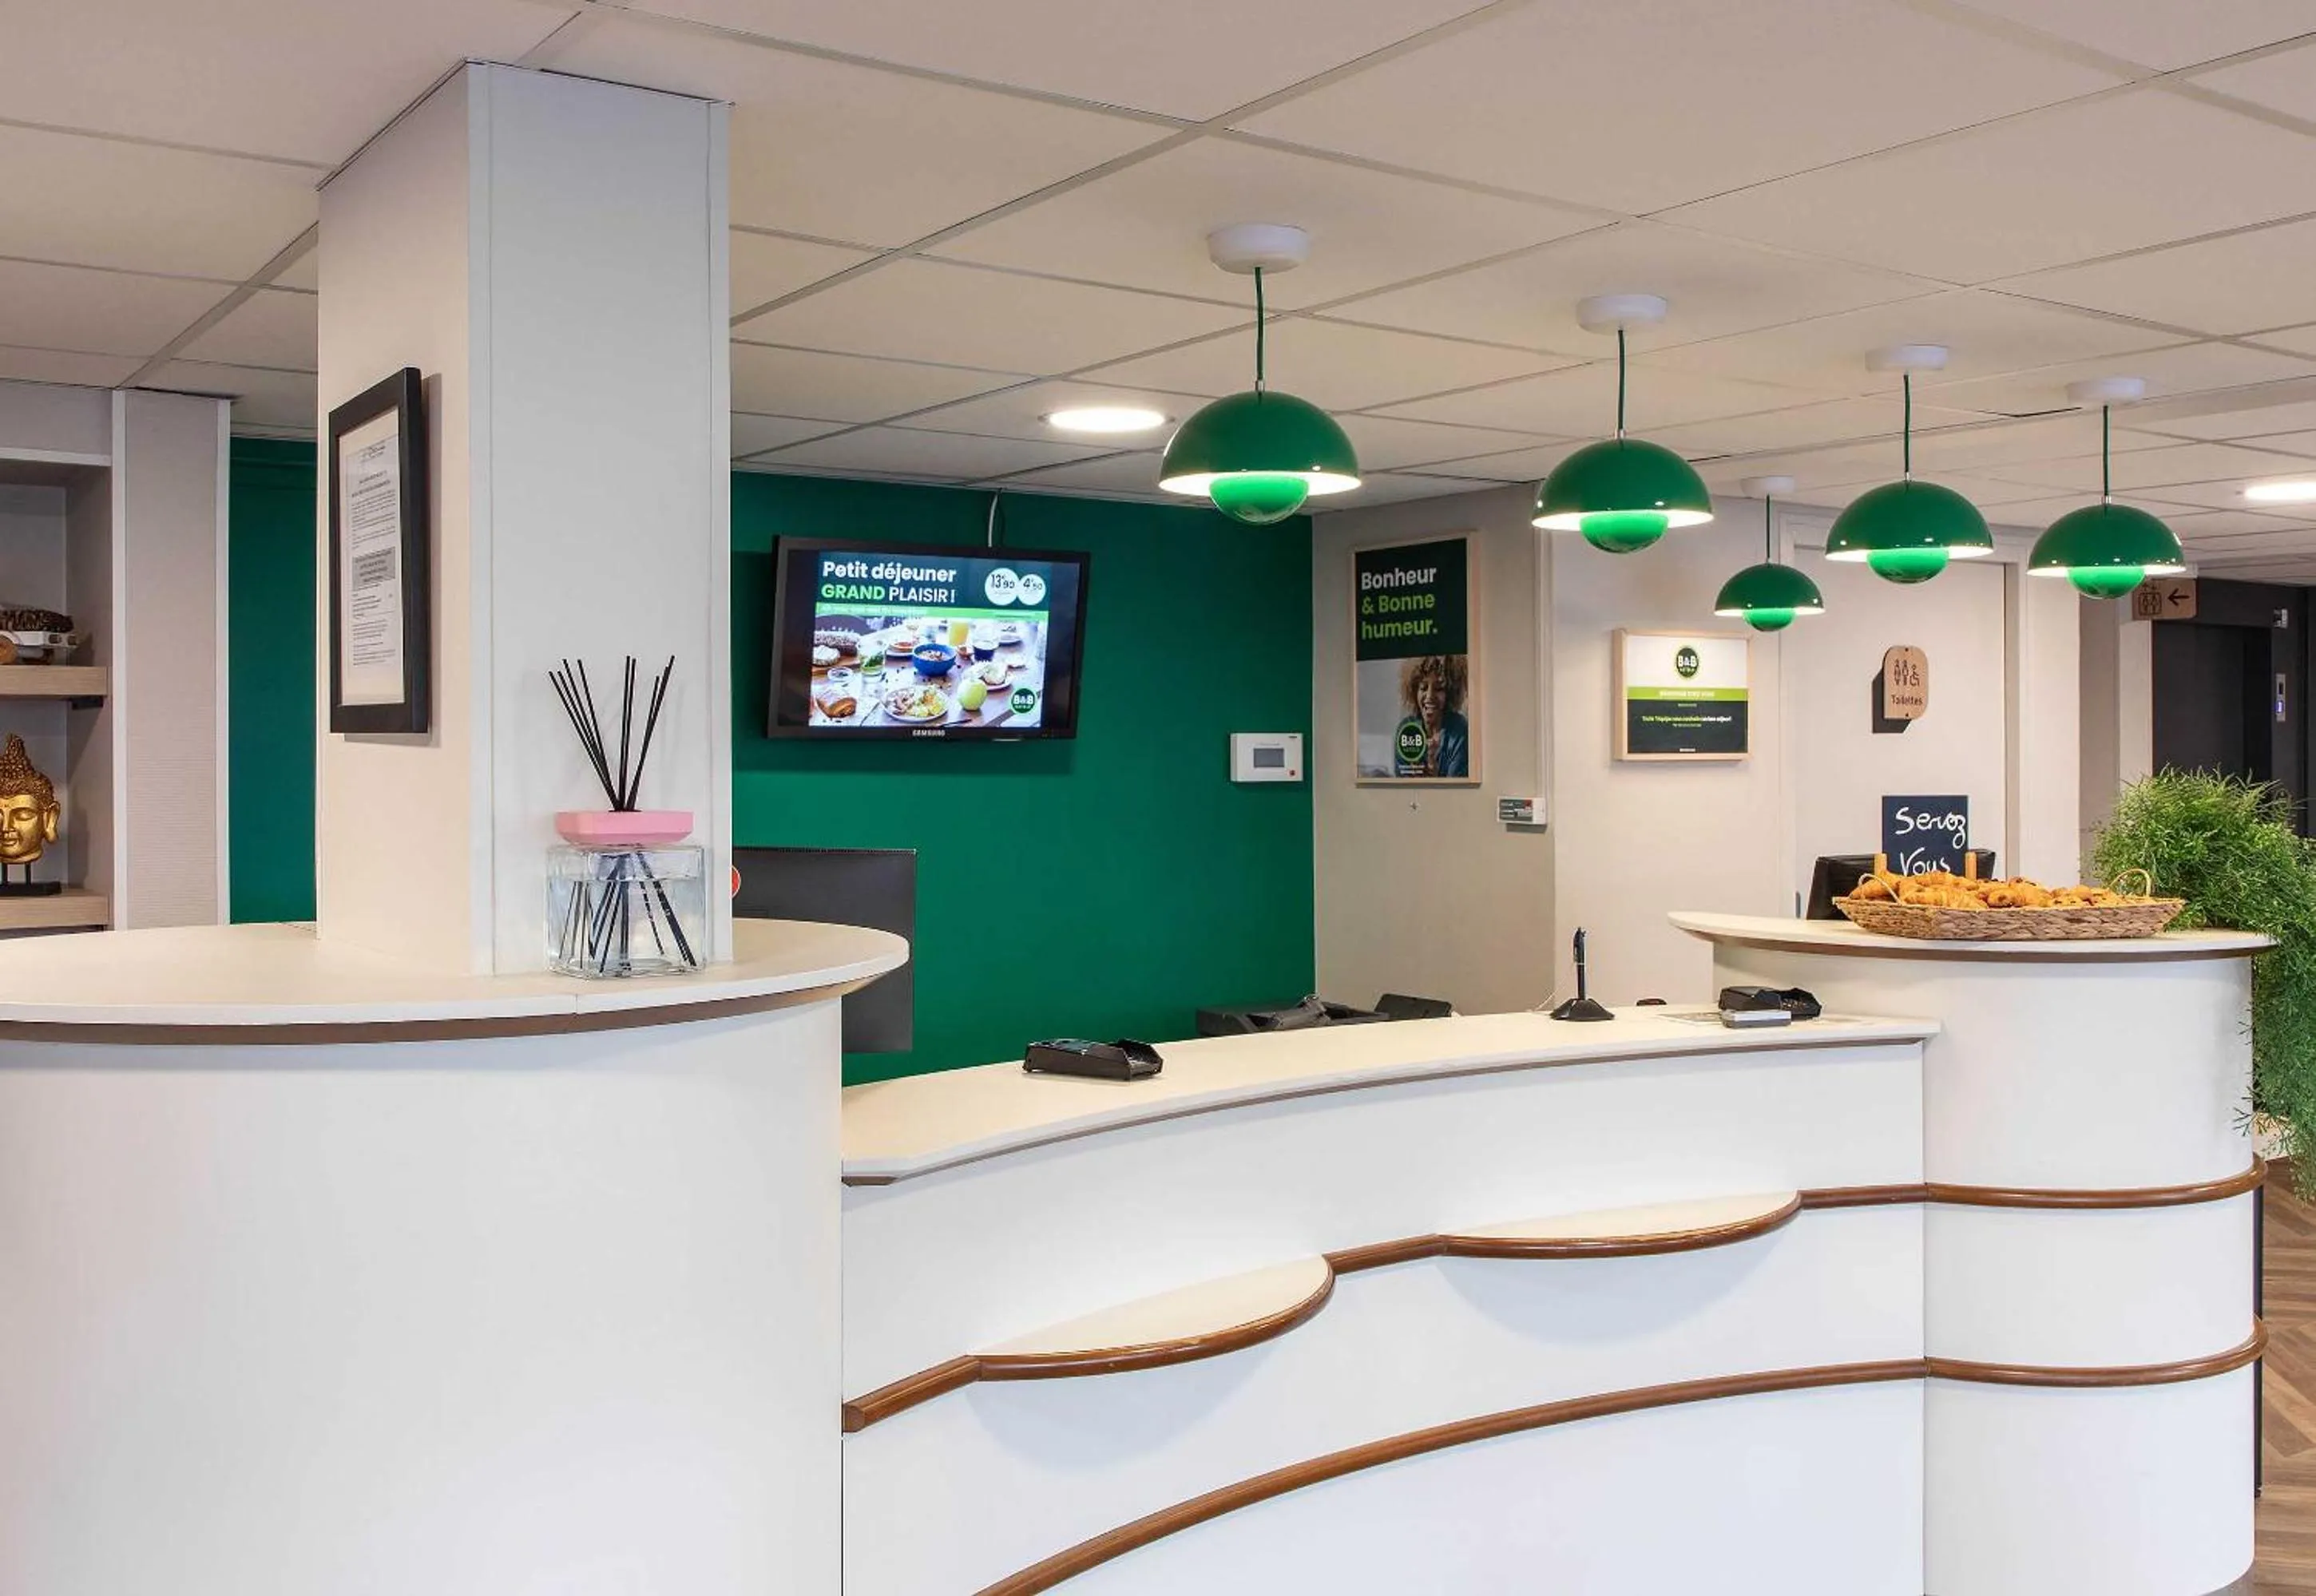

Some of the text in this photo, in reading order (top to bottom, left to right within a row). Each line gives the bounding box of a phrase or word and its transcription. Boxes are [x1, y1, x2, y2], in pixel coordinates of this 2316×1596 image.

[823, 561, 957, 585] Petit déjeuner
[1362, 568, 1437, 590] Bonheur
[821, 584, 886, 600] GRAND
[1362, 594, 1435, 614] & Bonne
[1362, 620, 1438, 640] humeur.
[1678, 655, 1697, 667] B&B
[1402, 735, 1422, 747] B&B
